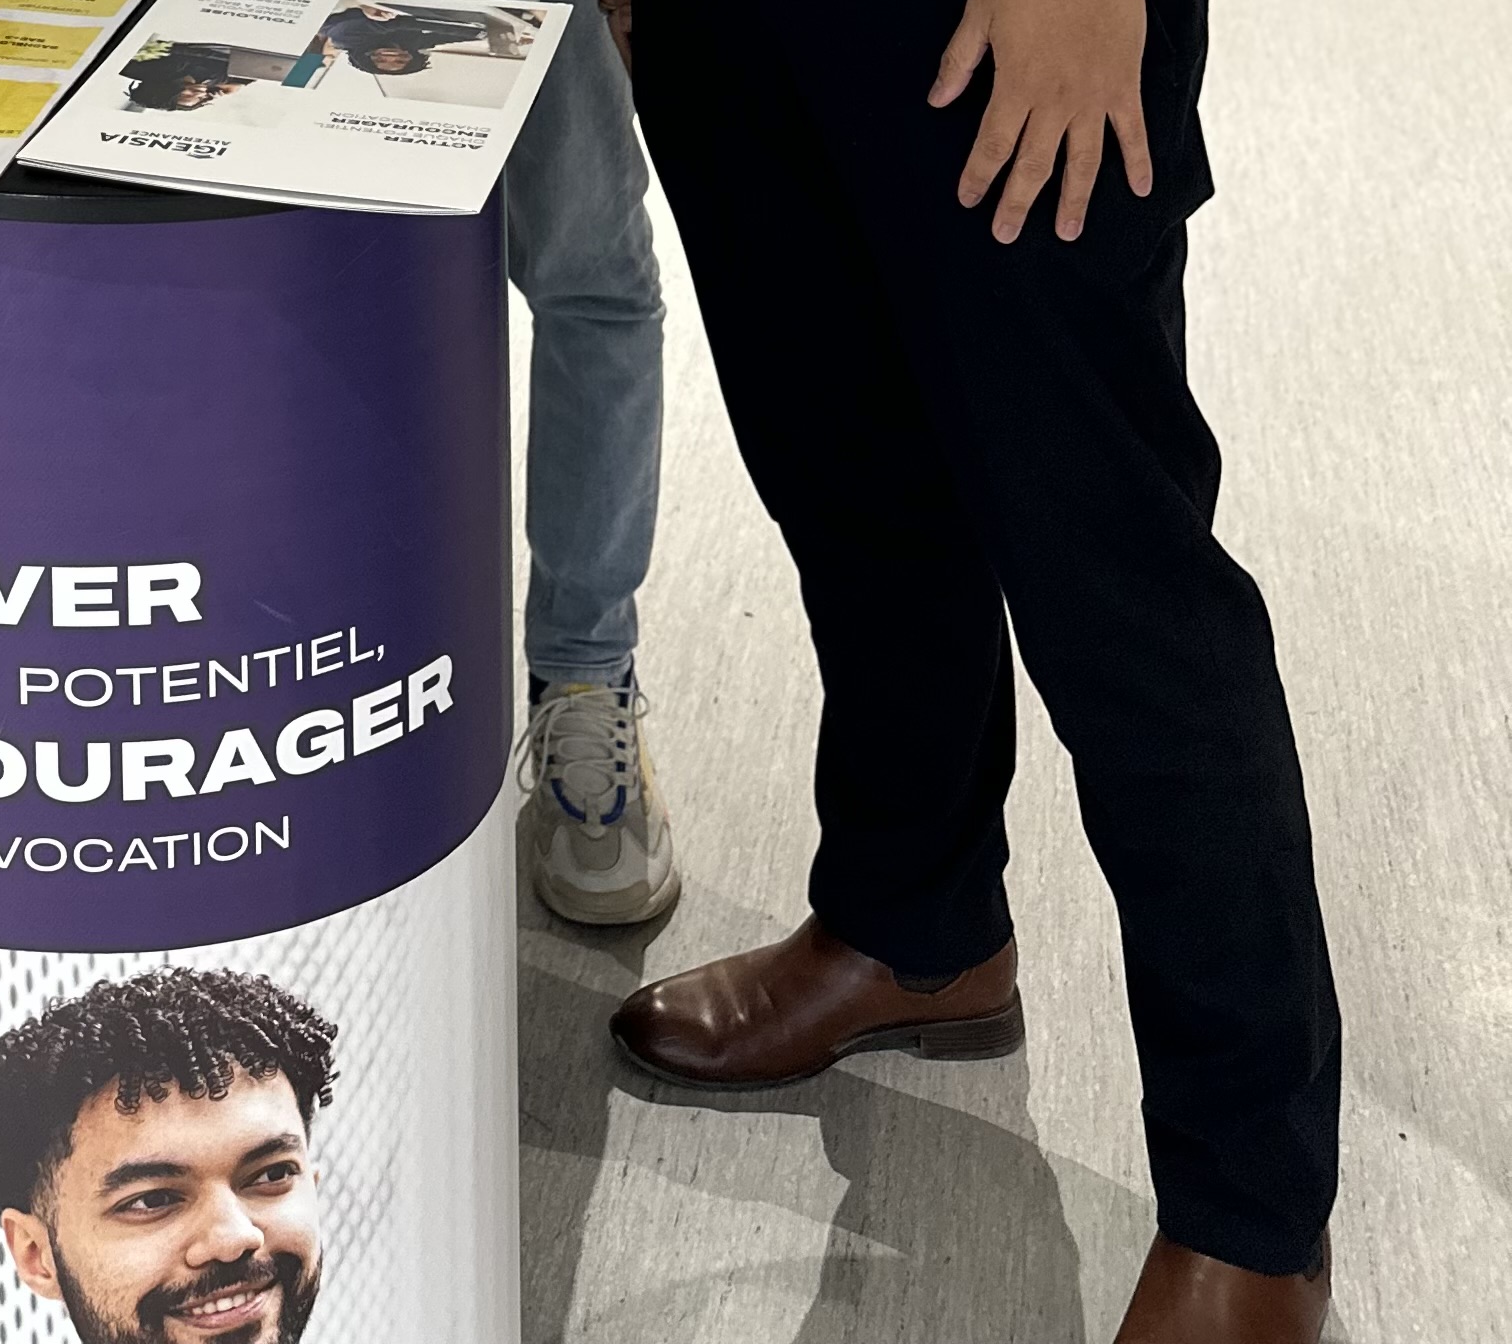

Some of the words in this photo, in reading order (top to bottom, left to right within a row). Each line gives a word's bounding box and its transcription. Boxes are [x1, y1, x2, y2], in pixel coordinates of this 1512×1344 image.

[199, 7, 297, 25] TOULOUSE
[329, 111, 414, 125] VOCATION
[418, 120, 492, 133] CHAQUE
[330, 117, 489, 139] ENCOURAGER
[98, 132, 228, 156] IGENSIA
[128, 129, 231, 146] ALTERNANCE
[383, 136, 484, 150] ACTIVER
[412, 132, 486, 145] CHAQUE
[18, 626, 387, 708] POTENTIEL,
